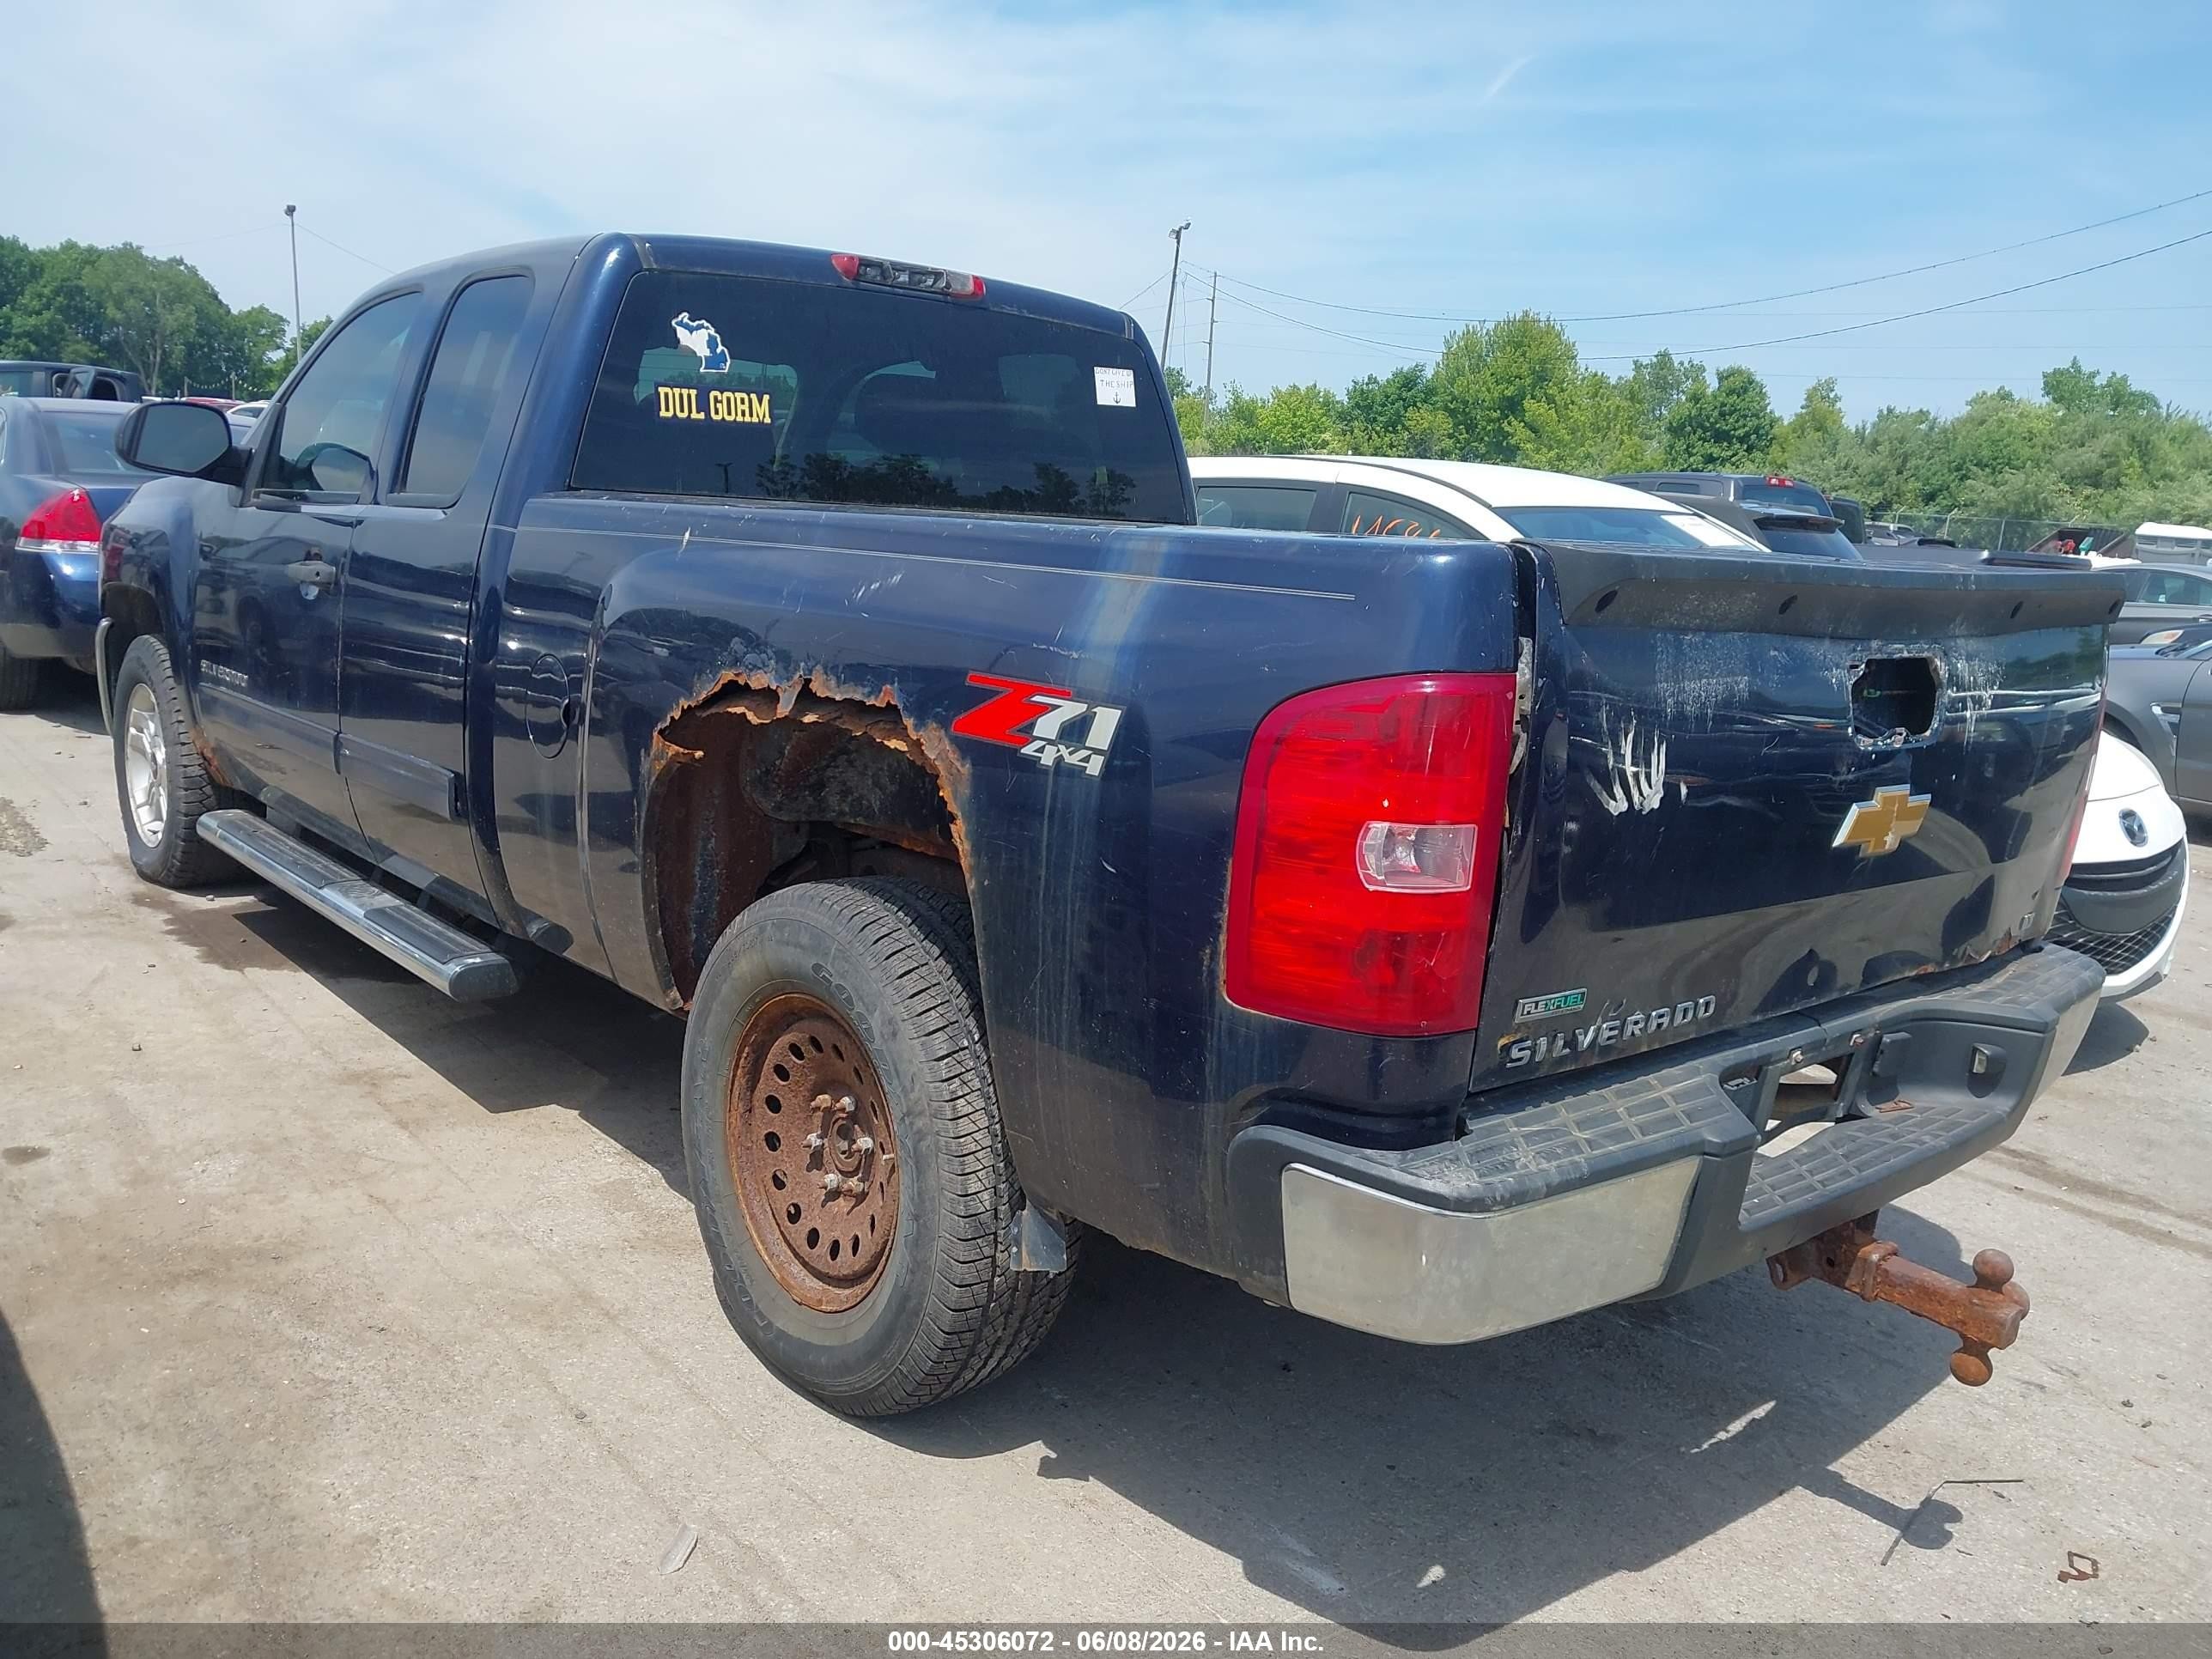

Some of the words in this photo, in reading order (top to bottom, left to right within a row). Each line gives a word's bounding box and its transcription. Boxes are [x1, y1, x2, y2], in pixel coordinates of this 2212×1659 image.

[1099, 379, 1115, 388] THE
[1115, 380, 1133, 390] SHIP
[658, 386, 705, 418] DUL
[709, 390, 772, 423] GORM
[951, 672, 1122, 751] Z71
[1522, 993, 1583, 1015] FLEXFUEL
[1505, 994, 1717, 1068] SILVERADO
